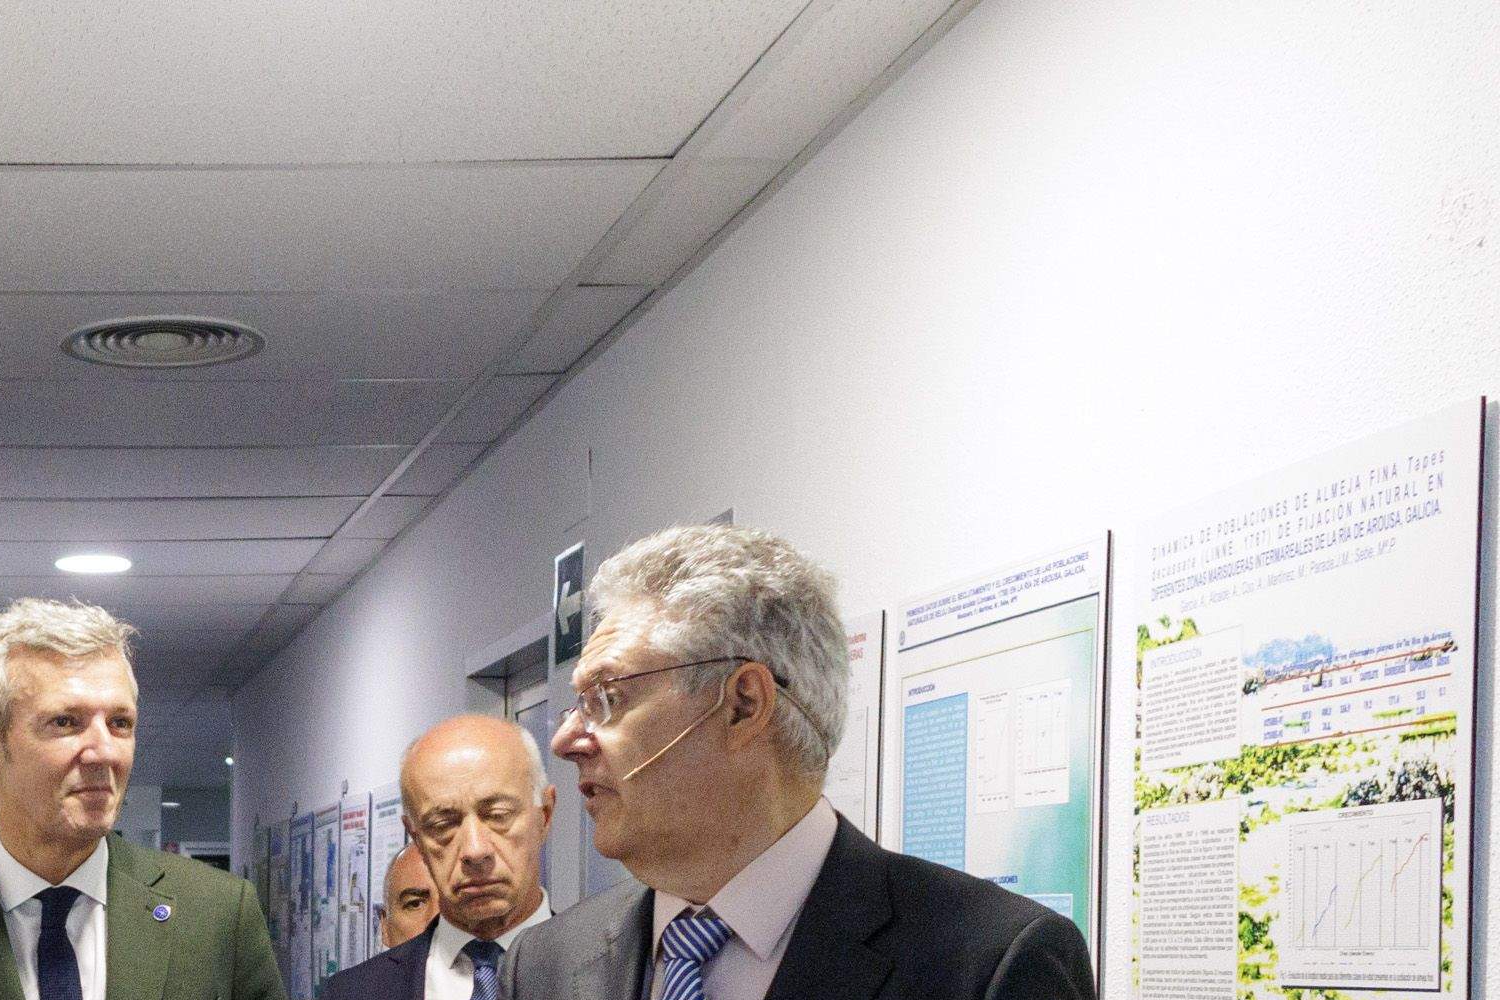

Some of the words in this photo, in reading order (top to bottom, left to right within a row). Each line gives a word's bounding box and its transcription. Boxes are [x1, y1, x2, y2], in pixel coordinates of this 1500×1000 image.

[1200, 527, 1212, 545] DE
[1216, 499, 1289, 538] POBLACIONES
[1295, 492, 1309, 512] DE
[1316, 474, 1362, 504] ALMEJA
[1369, 462, 1398, 487] FINA
[1407, 449, 1446, 477] Tapes
[1277, 521, 1291, 540] DE
[1360, 484, 1419, 514] NATURAL
[1427, 471, 1445, 493] EN
[1254, 540, 1314, 570] INTERMAREALES
[1353, 520, 1365, 539] DE
